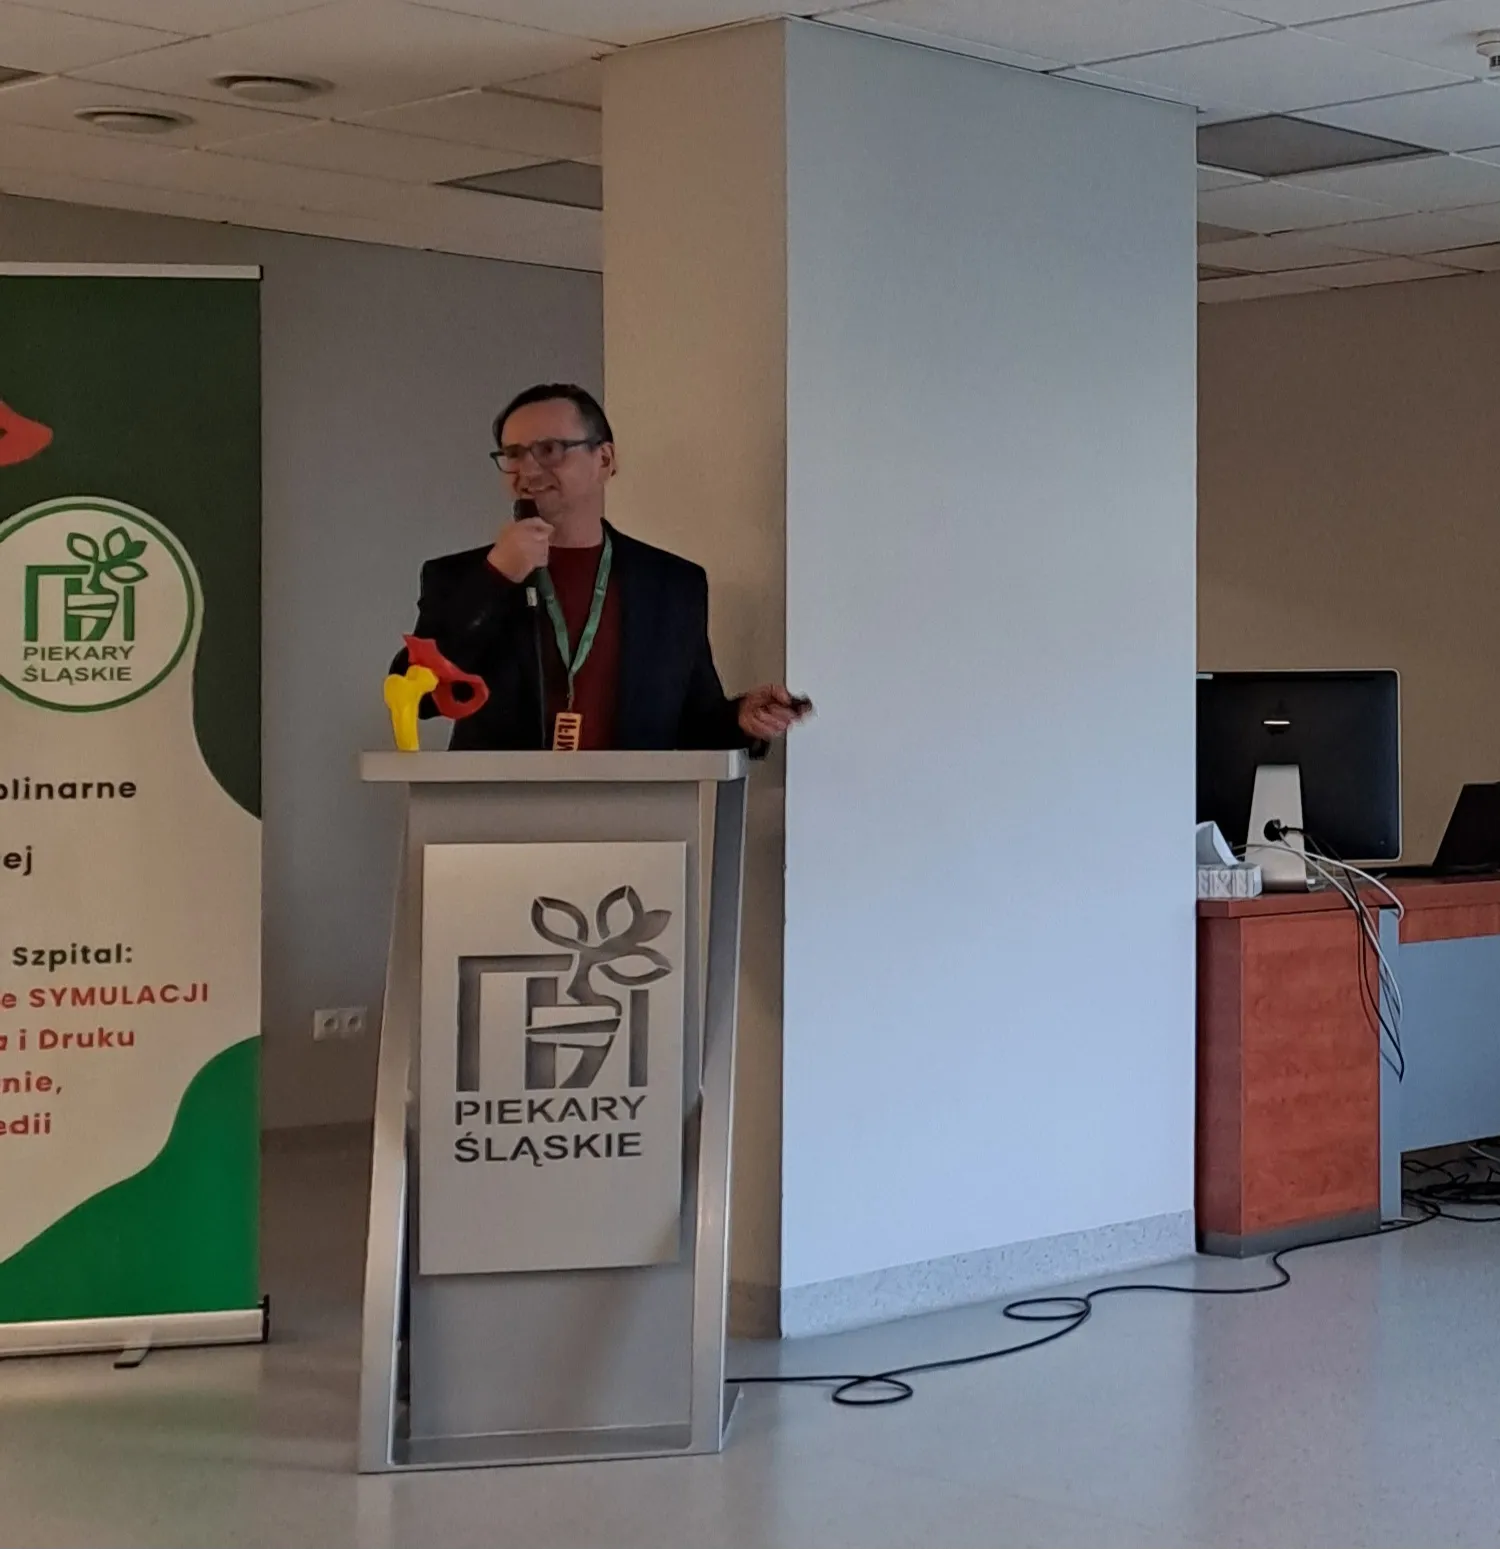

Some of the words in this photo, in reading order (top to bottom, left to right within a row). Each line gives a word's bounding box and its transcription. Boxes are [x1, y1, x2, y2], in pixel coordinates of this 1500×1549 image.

[23, 645, 135, 662] PIEKARY
[22, 665, 133, 686] ŚLĄSKIE
[12, 943, 133, 973] Szpital:
[29, 983, 209, 1008] SYMULACJI
[19, 1029, 27, 1051] i
[39, 1028, 135, 1050] Druku
[455, 1096, 647, 1126] PIEKARY
[454, 1132, 643, 1167] ŚLĄSKIE
